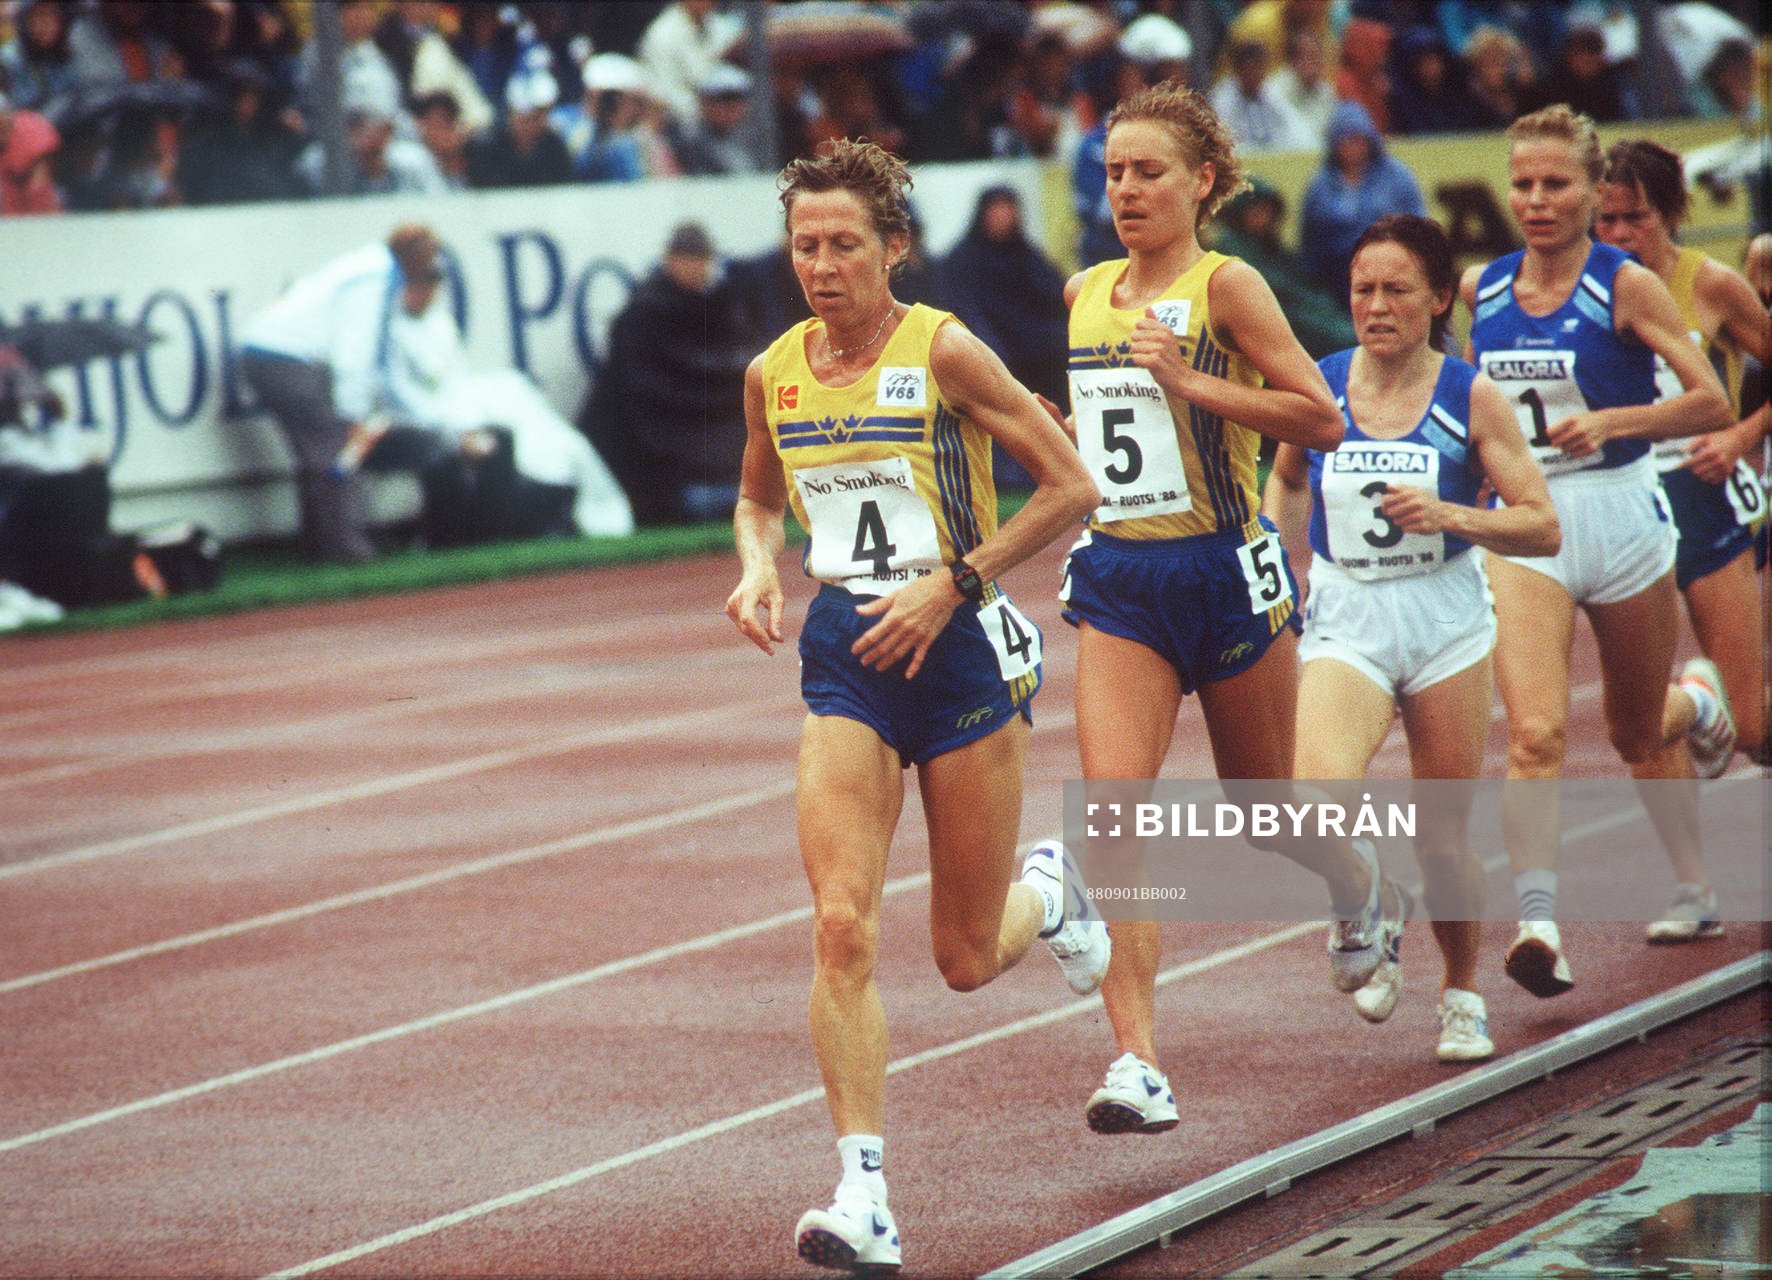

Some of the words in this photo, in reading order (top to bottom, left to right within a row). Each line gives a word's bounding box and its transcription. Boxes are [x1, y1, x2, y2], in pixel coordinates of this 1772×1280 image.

[1156, 316, 1178, 328] 65
[1489, 361, 1565, 379] SALORA
[885, 386, 915, 399] V65
[1097, 382, 1161, 402] Smoking
[1518, 387, 1554, 446] 1
[1102, 408, 1143, 485] 5
[1335, 452, 1426, 472] SALORA
[803, 479, 832, 498] No
[1360, 481, 1405, 548] 3
[851, 500, 897, 573] 4
[1249, 537, 1282, 602] 5
[998, 604, 1032, 664] 4
